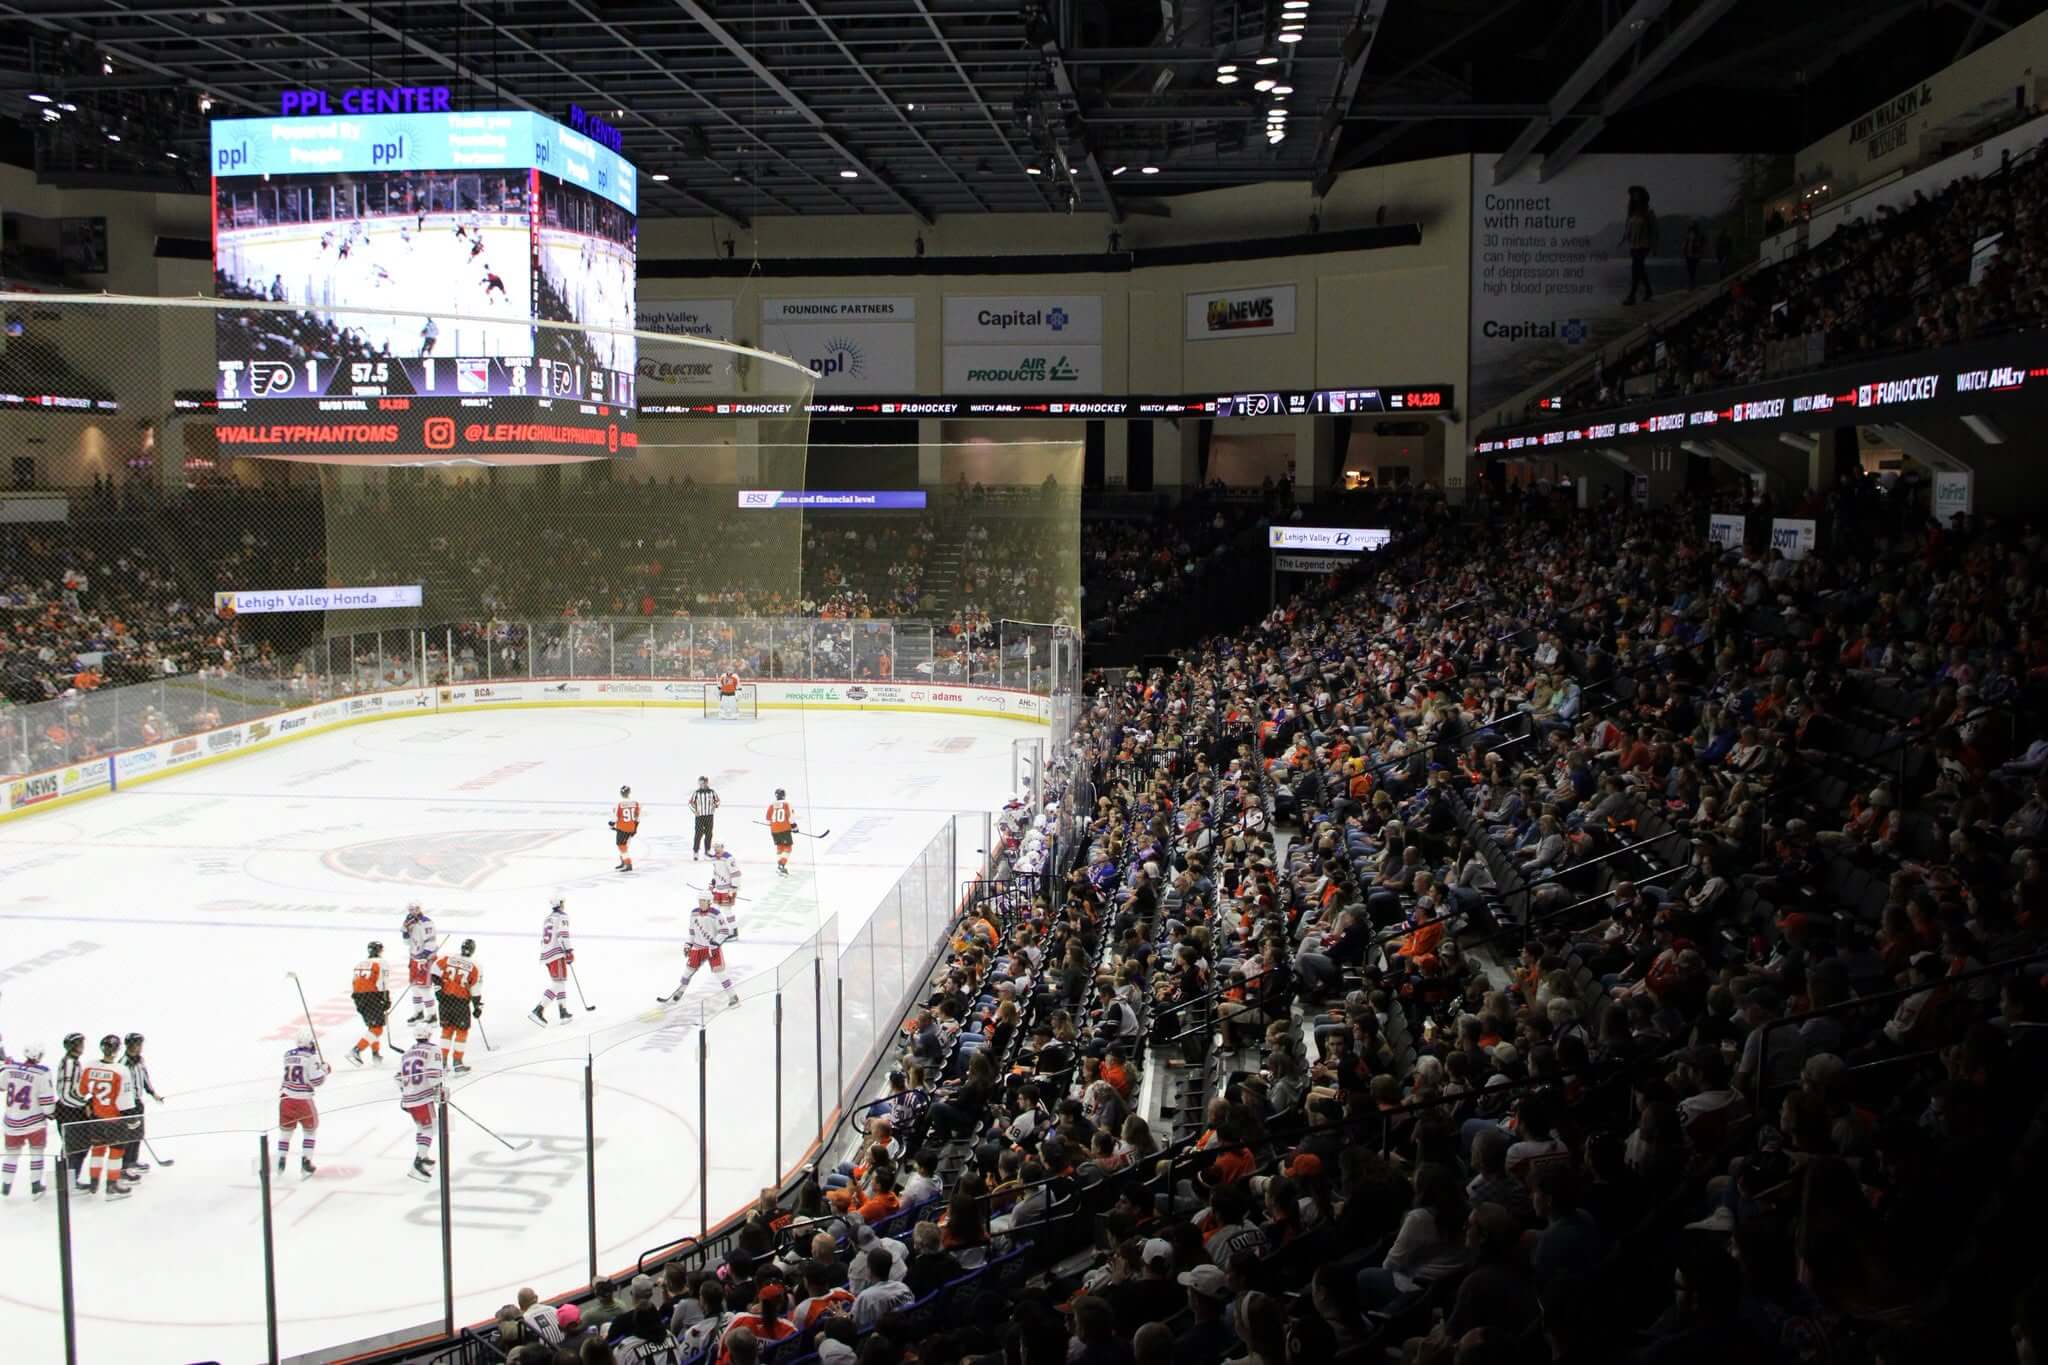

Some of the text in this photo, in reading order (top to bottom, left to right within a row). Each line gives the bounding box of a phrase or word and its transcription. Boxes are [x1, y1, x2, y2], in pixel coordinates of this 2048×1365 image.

[281, 87, 451, 116] PPL CENTER
[218, 141, 247, 170] ppl
[373, 135, 403, 165] ppl
[536, 140, 550, 165] ppl
[1485, 194, 1551, 211] Connect
[1484, 212, 1576, 229] with nature
[1483, 234, 1498, 248] 30
[1502, 234, 1546, 248] minutes
[1483, 253, 1505, 263] can
[1508, 251, 1532, 267] help
[1535, 251, 1586, 263] decrease
[1483, 266, 1584, 283] of depression and
[1483, 282, 1593, 297] high blood pressure
[783, 303, 894, 314] FOUNDING PARTNERS
[1229, 299, 1273, 320] NEWS
[666, 312, 698, 324] Valley
[978, 310, 1041, 329] Capital
[1483, 320, 1556, 341] Capital
[810, 352, 844, 377] ppl
[1020, 358, 1045, 370] AIR
[305, 360, 317, 392] 1
[351, 363, 388, 383] 57.5
[423, 359, 435, 391] 1
[967, 370, 1046, 382] PRODUCTS
[1957, 371, 1987, 391] WATCH
[1407, 393, 1440, 407] $4,220
[1793, 398, 1812, 413] WATCH
[1877, 375, 1939, 405] FLOHOCKEY
[735, 404, 791, 413] FLOHOCKEY
[901, 404, 958, 413] FLOHOCKEY
[970, 404, 994, 412] WATCH
[1069, 404, 1127, 413] FLOHOCKEY
[1140, 404, 1164, 412] WATCH
[1273, 396, 1279, 413] 1
[1317, 394, 1323, 412] 1
[1285, 530, 1308, 542] Lehigh
[1309, 529, 1330, 543] Valley
[1711, 522, 1731, 541] SCOTT
[1773, 529, 1798, 548] SCOTT
[1279, 559, 1335, 570] The Legend of
[236, 591, 377, 609] Lehigh Valley Honda
[932, 691, 962, 702] adams
[25, 775, 57, 797] NEWS
[7, 1082, 32, 1111] 84
